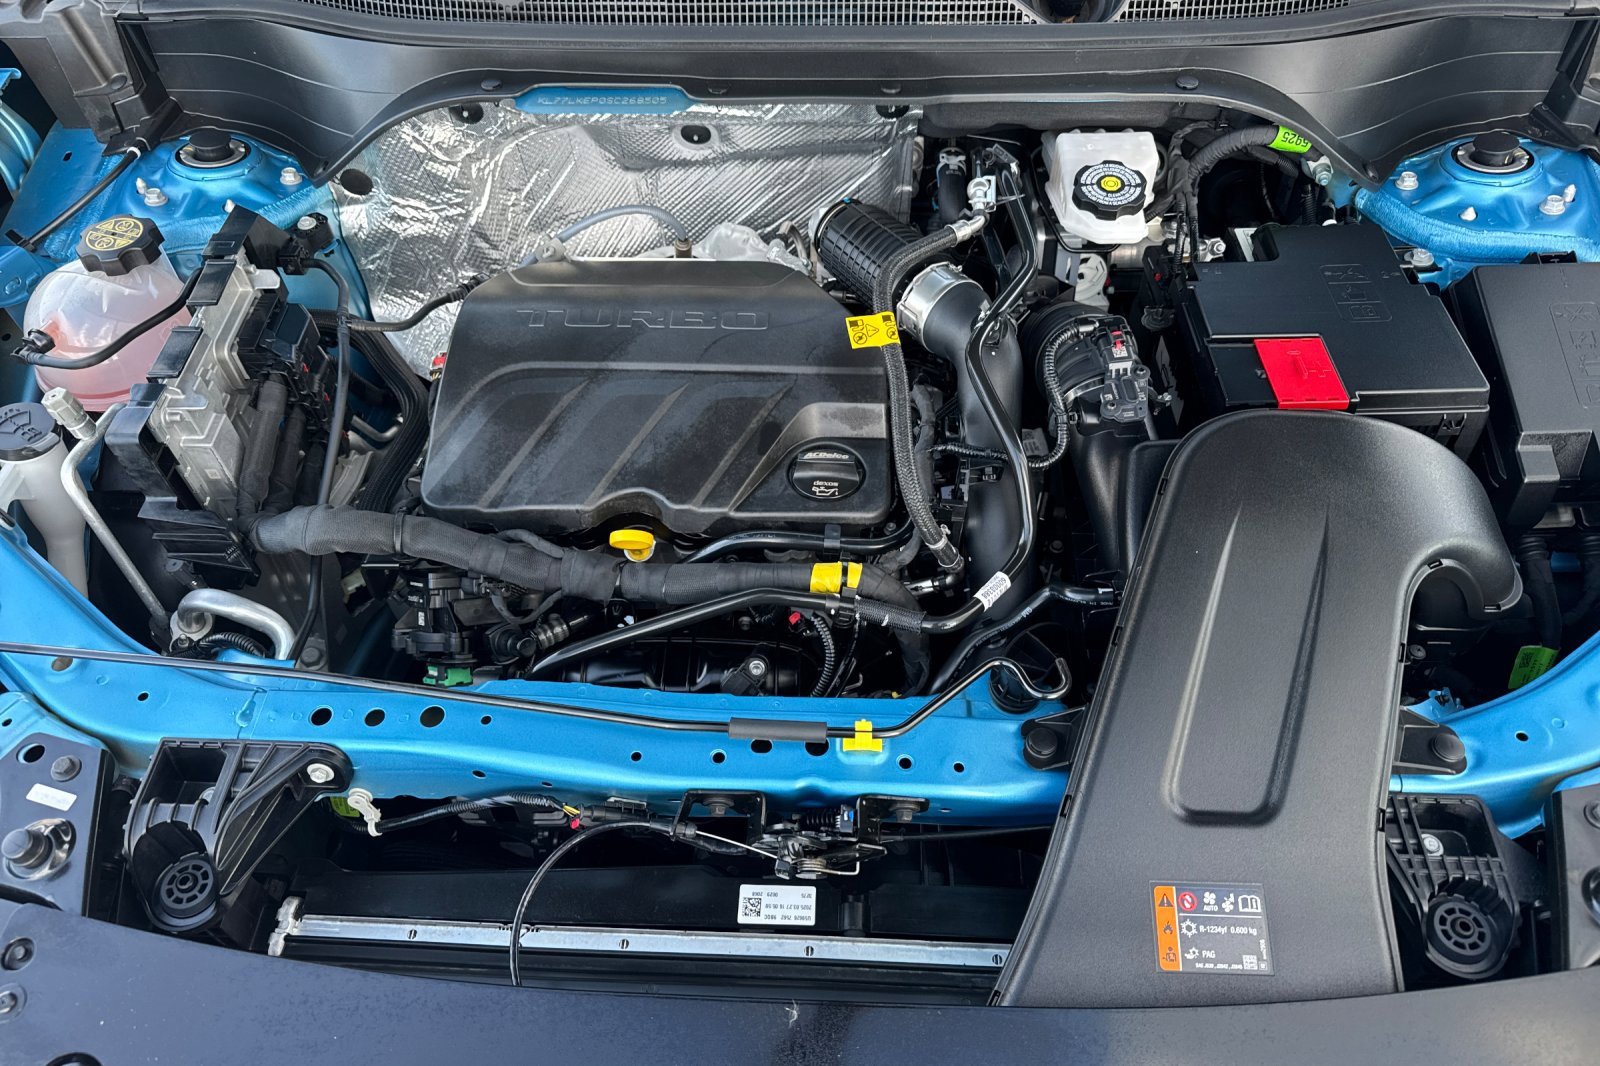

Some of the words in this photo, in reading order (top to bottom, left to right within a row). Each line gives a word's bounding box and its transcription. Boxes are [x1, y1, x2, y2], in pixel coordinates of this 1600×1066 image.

[516, 309, 771, 331] TURBO
[1199, 925, 1228, 935] R-1234yf
[1230, 926, 1248, 934] 0.600
[1248, 926, 1257, 936] kg
[1202, 950, 1216, 959] PAG
